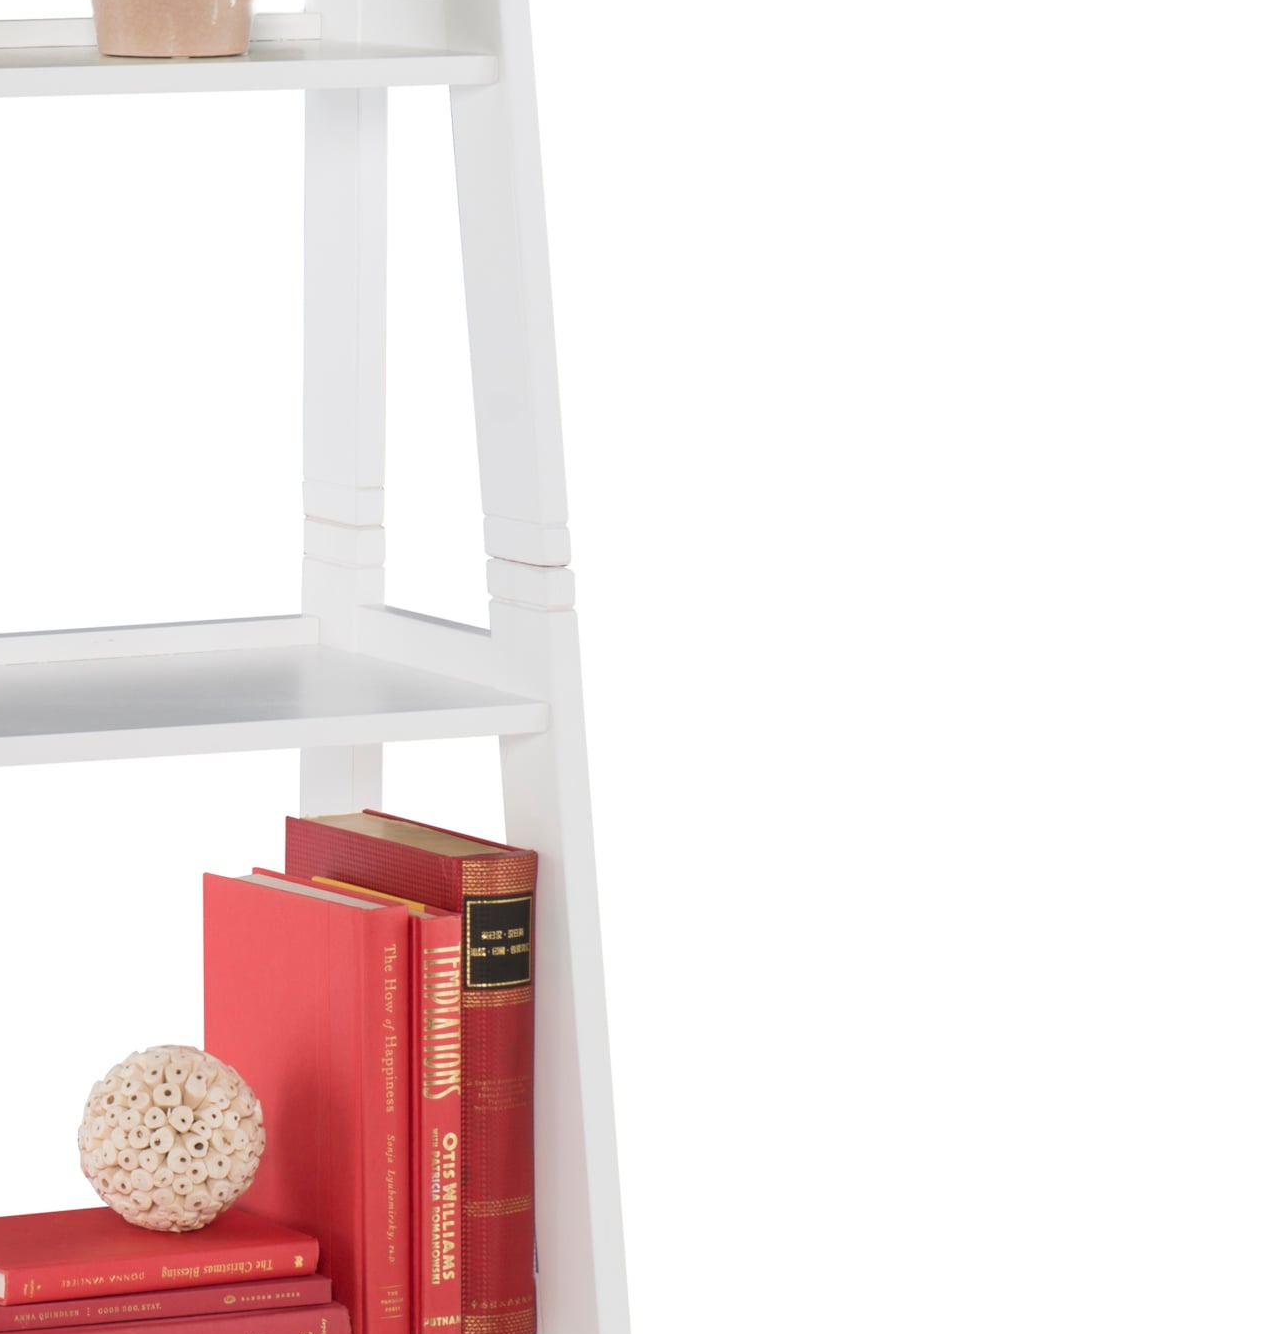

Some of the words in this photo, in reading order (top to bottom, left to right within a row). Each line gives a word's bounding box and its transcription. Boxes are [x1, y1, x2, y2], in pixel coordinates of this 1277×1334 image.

[384, 944, 398, 972] The
[384, 979, 397, 1013] How
[382, 1018, 395, 1031] of
[423, 940, 461, 1099] TEMPTATIONS
[381, 1036, 398, 1113] Happiness
[385, 1134, 396, 1164] Sonja
[442, 1132, 458, 1179] OTIS
[431, 1150, 441, 1202] PATRICIA
[431, 1206, 441, 1285] ROMANOWSKI
[442, 1182, 457, 1280] WILLIAMS
[109, 1271, 145, 1283] DONNA
[161, 1264, 201, 1278] Blessing
[203, 1260, 253, 1274] Christmas
[253, 1259, 274, 1270] The
